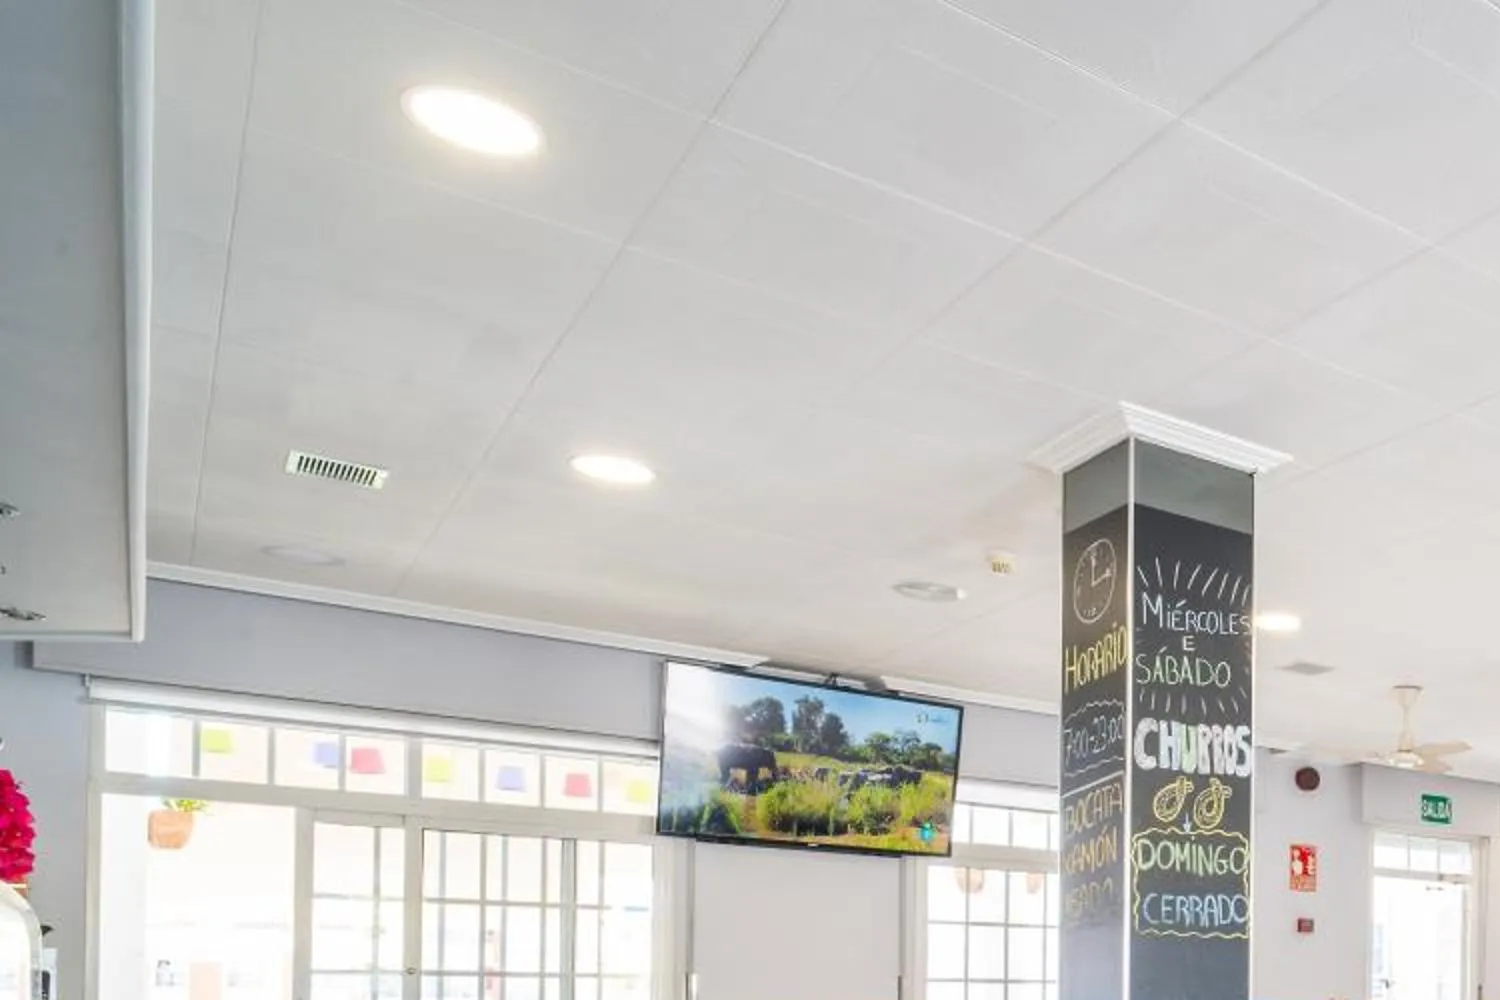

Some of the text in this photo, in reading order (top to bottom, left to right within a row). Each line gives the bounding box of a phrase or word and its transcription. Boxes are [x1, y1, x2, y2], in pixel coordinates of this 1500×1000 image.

[1183, 635, 1196, 651] E
[1135, 646, 1231, 688] SÁBADO
[1134, 717, 1252, 778] CHURROS
[1143, 893, 1249, 927] CERRADO
